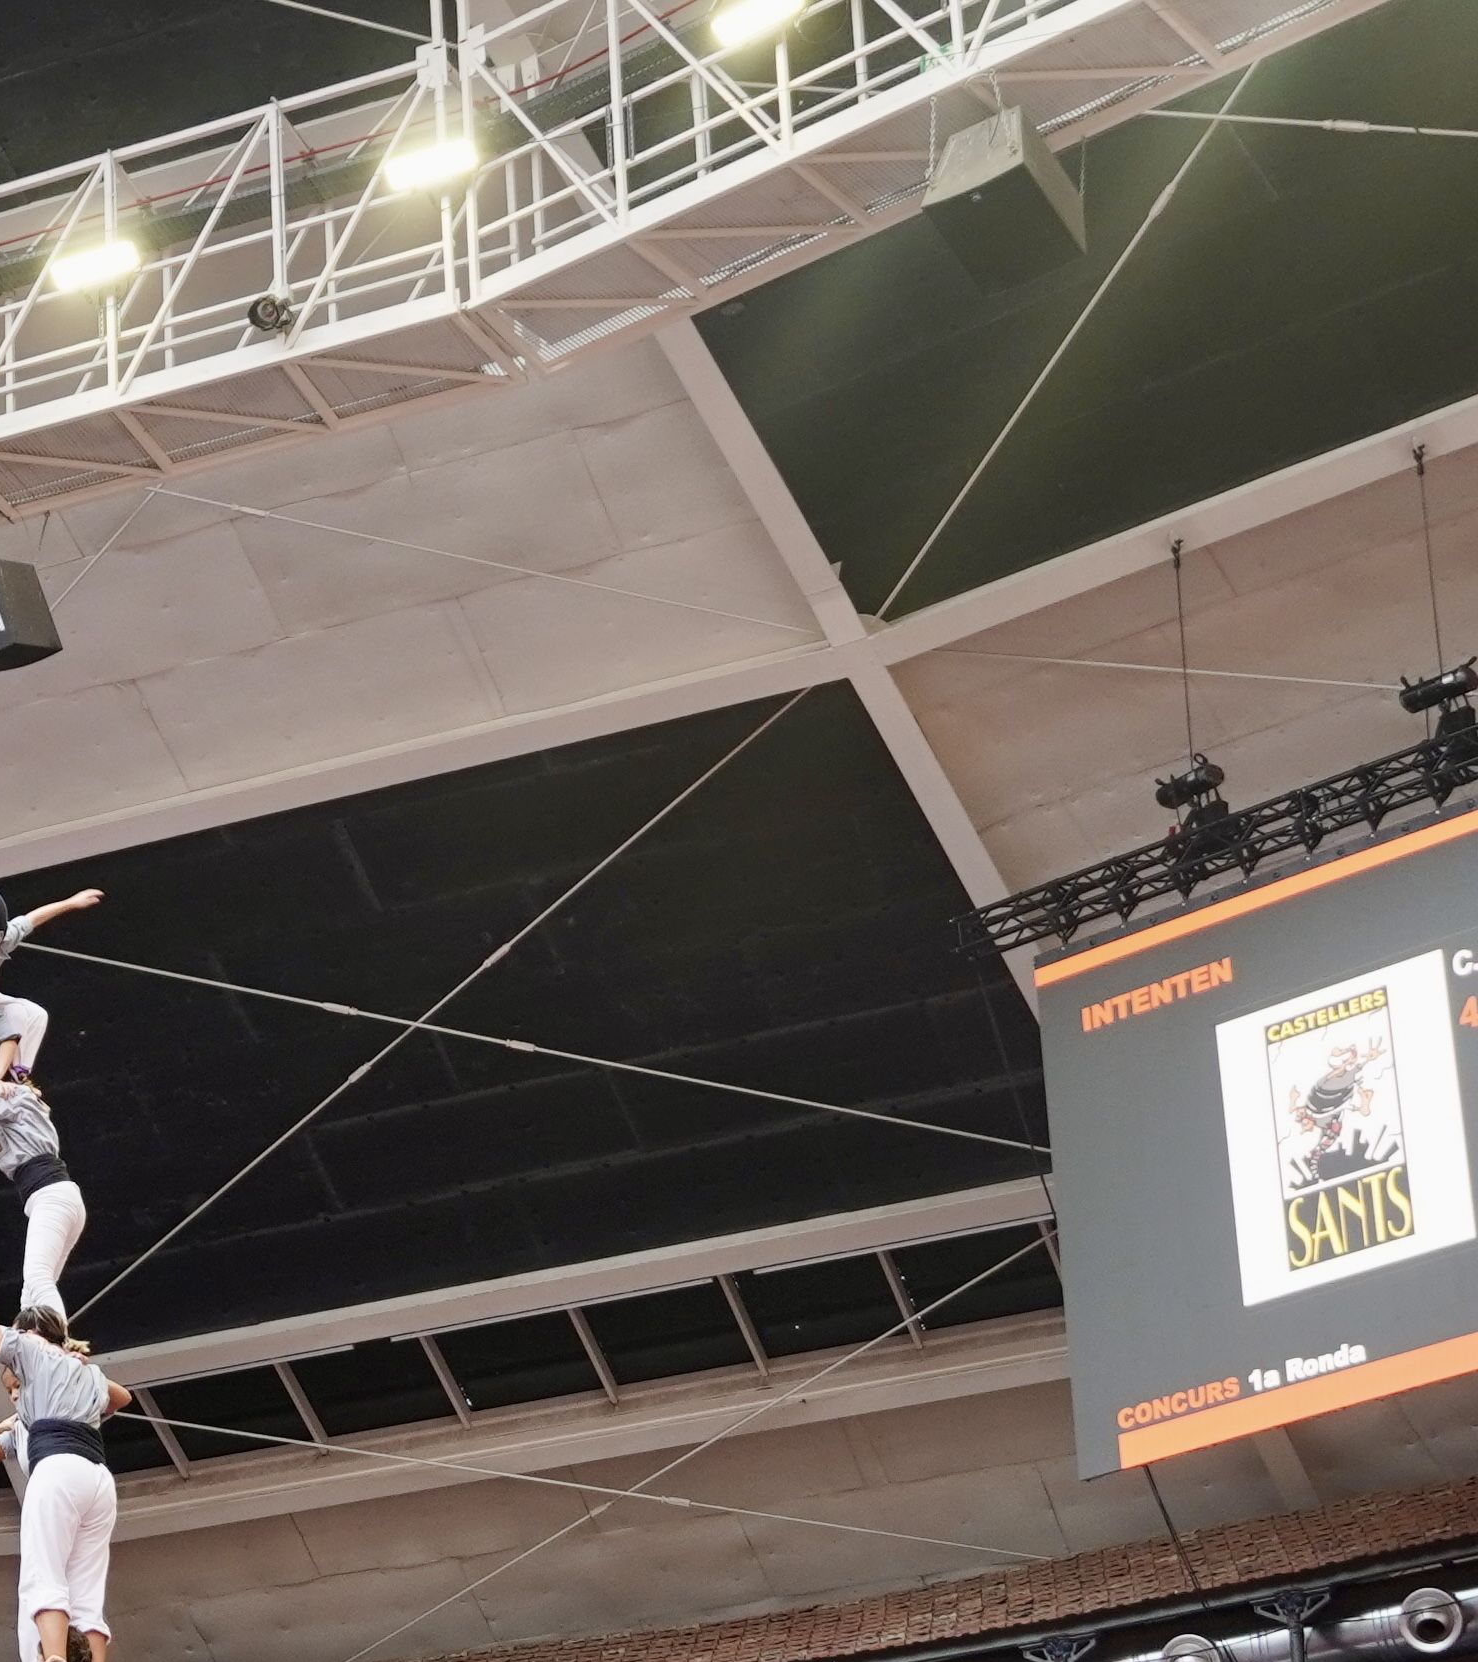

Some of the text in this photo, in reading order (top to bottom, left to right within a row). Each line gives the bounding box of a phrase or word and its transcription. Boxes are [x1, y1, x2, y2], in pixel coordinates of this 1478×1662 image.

[1080, 956, 1234, 1032] INTENTEN
[1267, 989, 1387, 1043] CASTELLERS
[1289, 1166, 1413, 1268] SANTS
[1116, 1343, 1367, 1429] CONCURS 1a Ronda
